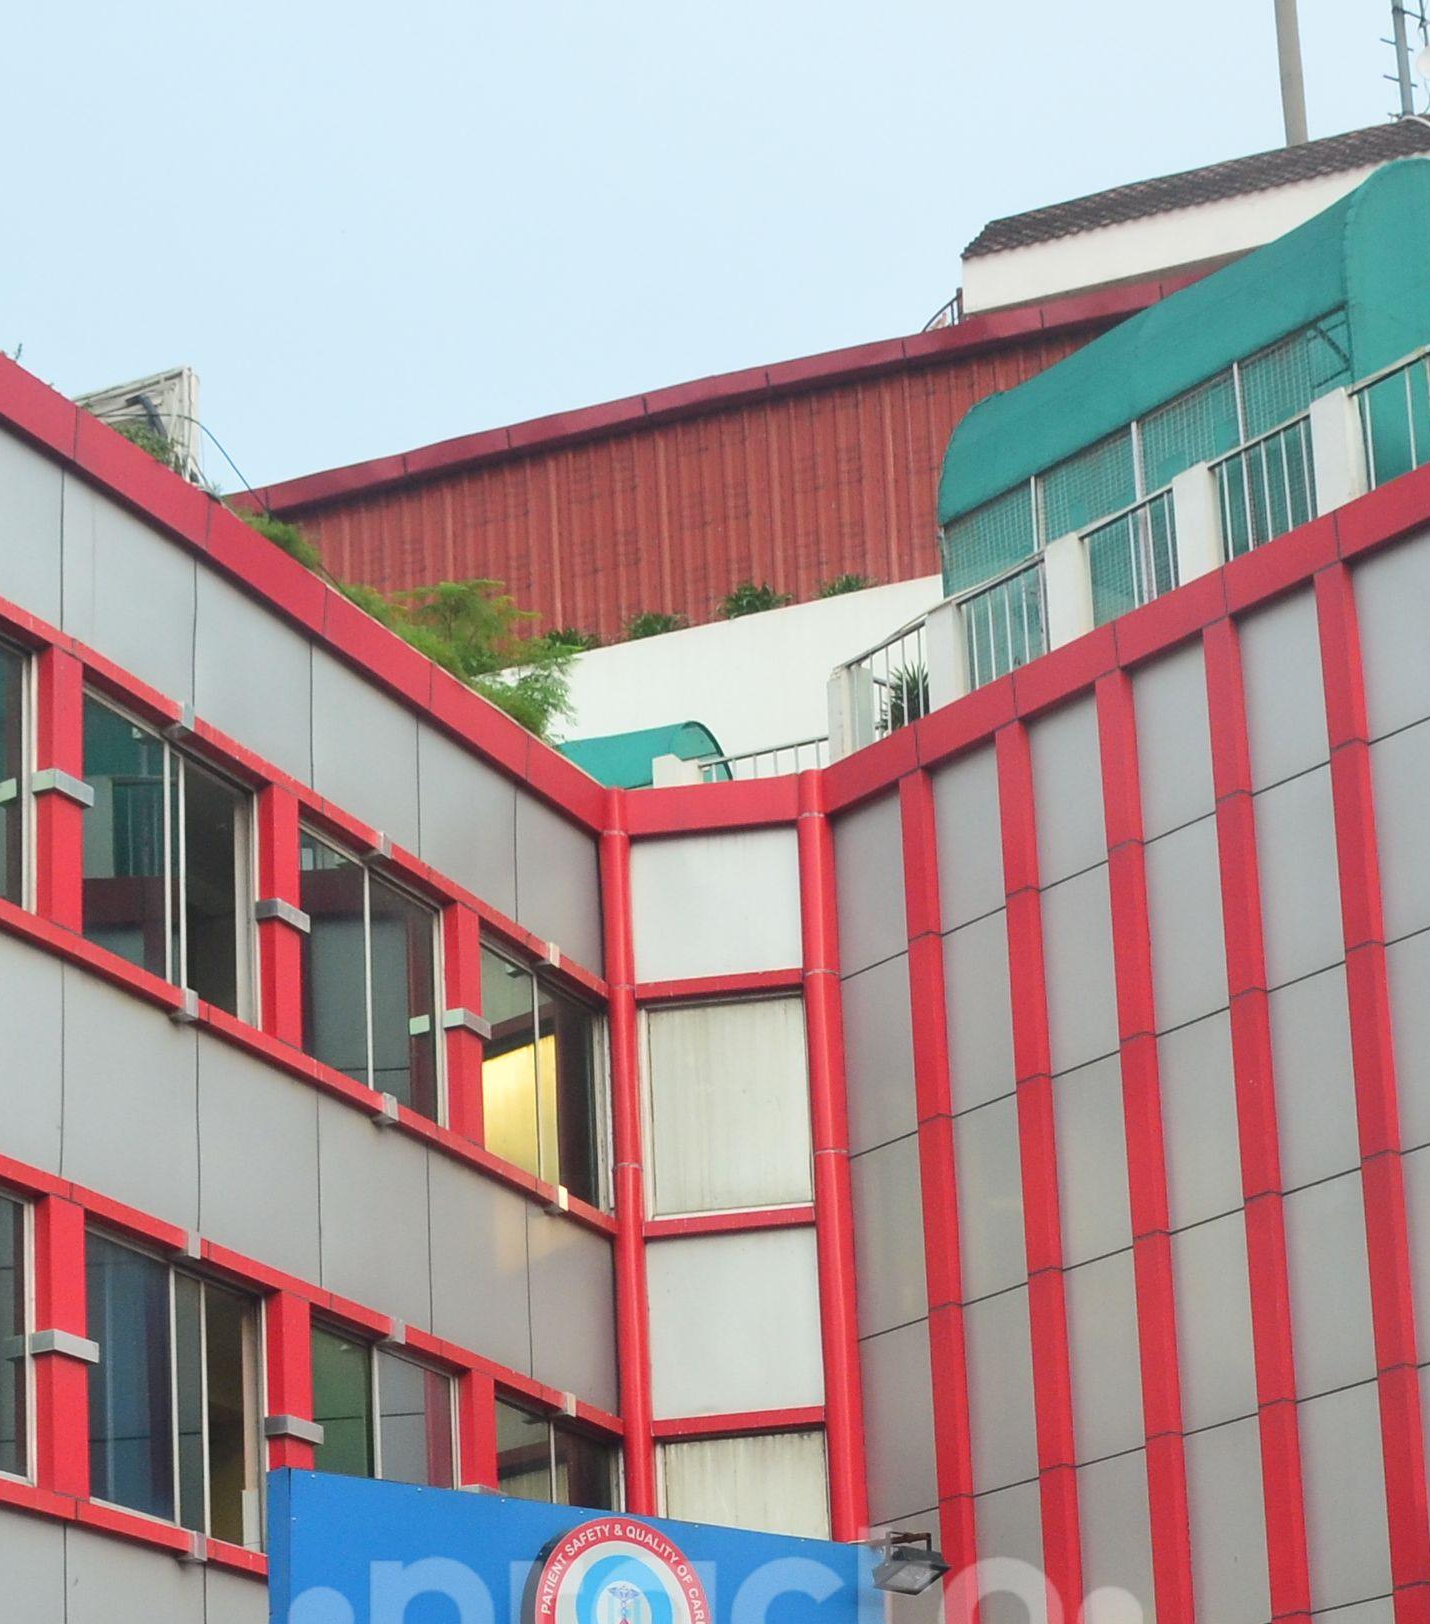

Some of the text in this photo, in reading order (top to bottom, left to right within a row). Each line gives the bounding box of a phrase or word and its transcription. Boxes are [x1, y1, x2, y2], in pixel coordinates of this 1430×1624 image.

[541, 1553, 568, 1615] PATIENT
[565, 1524, 610, 1557] SAFETY
[614, 1524, 623, 1536] &
[626, 1526, 679, 1564] QUALITY
[677, 1564, 693, 1583] OF
